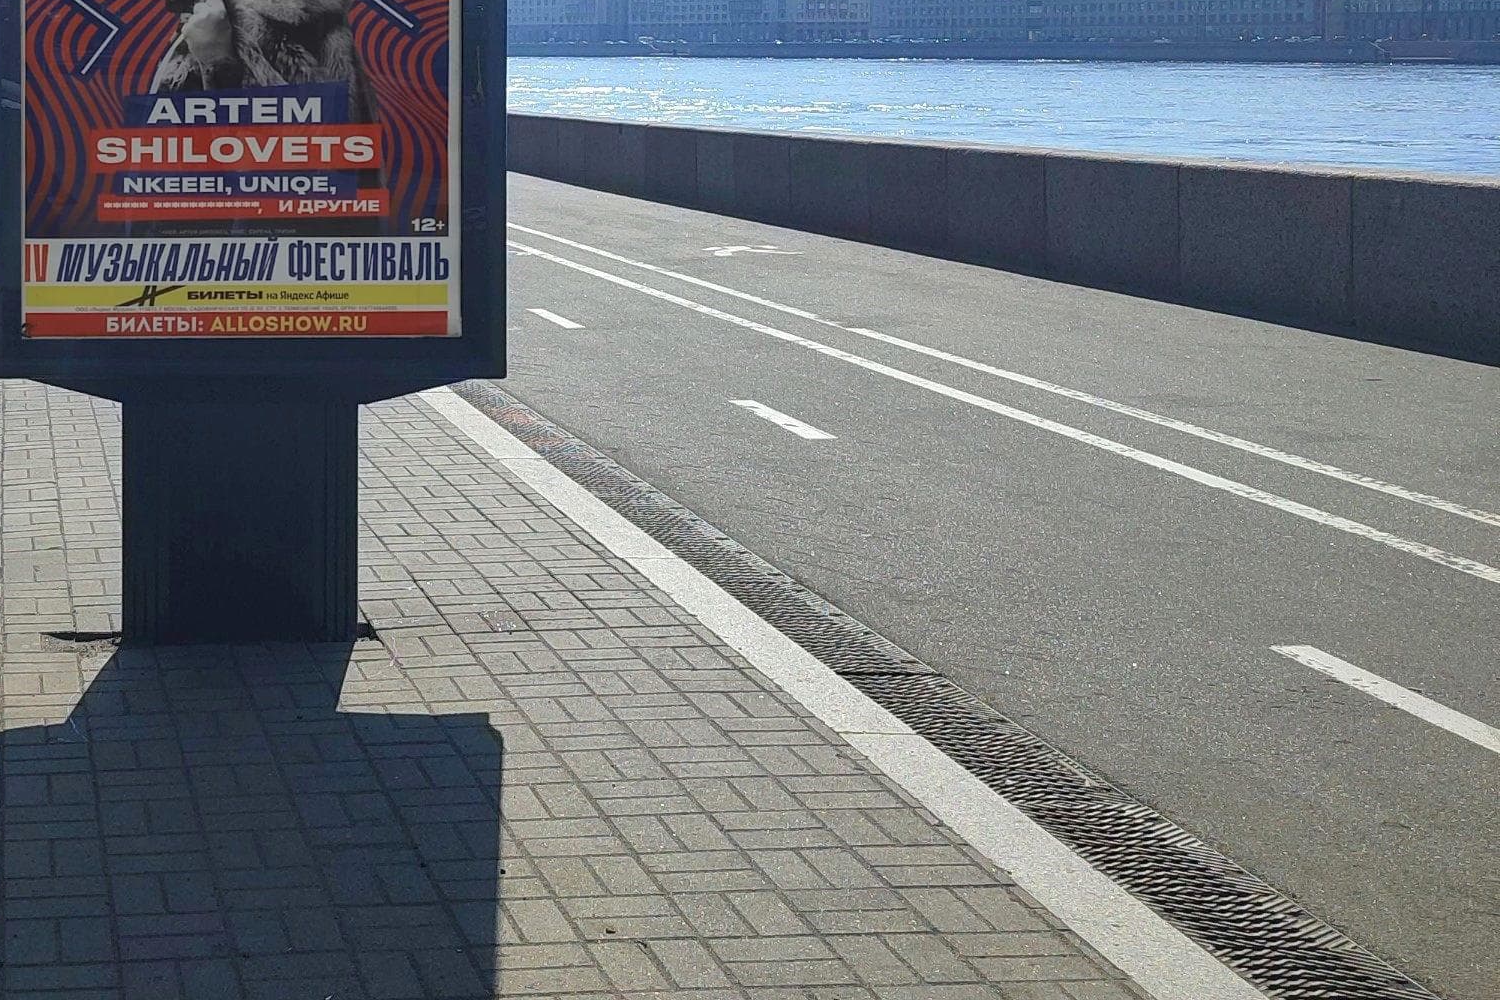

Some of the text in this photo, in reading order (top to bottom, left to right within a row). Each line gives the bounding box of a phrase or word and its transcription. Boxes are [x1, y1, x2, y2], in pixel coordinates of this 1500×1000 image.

[147, 97, 322, 124] ARTEM
[96, 136, 374, 163] SHILOVETS
[123, 175, 337, 195] NKEEEI, UNIQE,
[279, 200, 293, 212] И
[297, 200, 380, 215] ДРУГИЕ
[411, 218, 445, 232] 12+
[24, 235, 449, 283] IV МУЗЫКАЛЬНЫЙ ФЕСТИВАЛЬ
[187, 291, 263, 300] БИЛЕТЫ
[280, 290, 314, 301] Яндекс
[315, 290, 349, 301] Афише
[106, 316, 367, 333] БИЛЕТЫ: ALLOSHOW.RU
